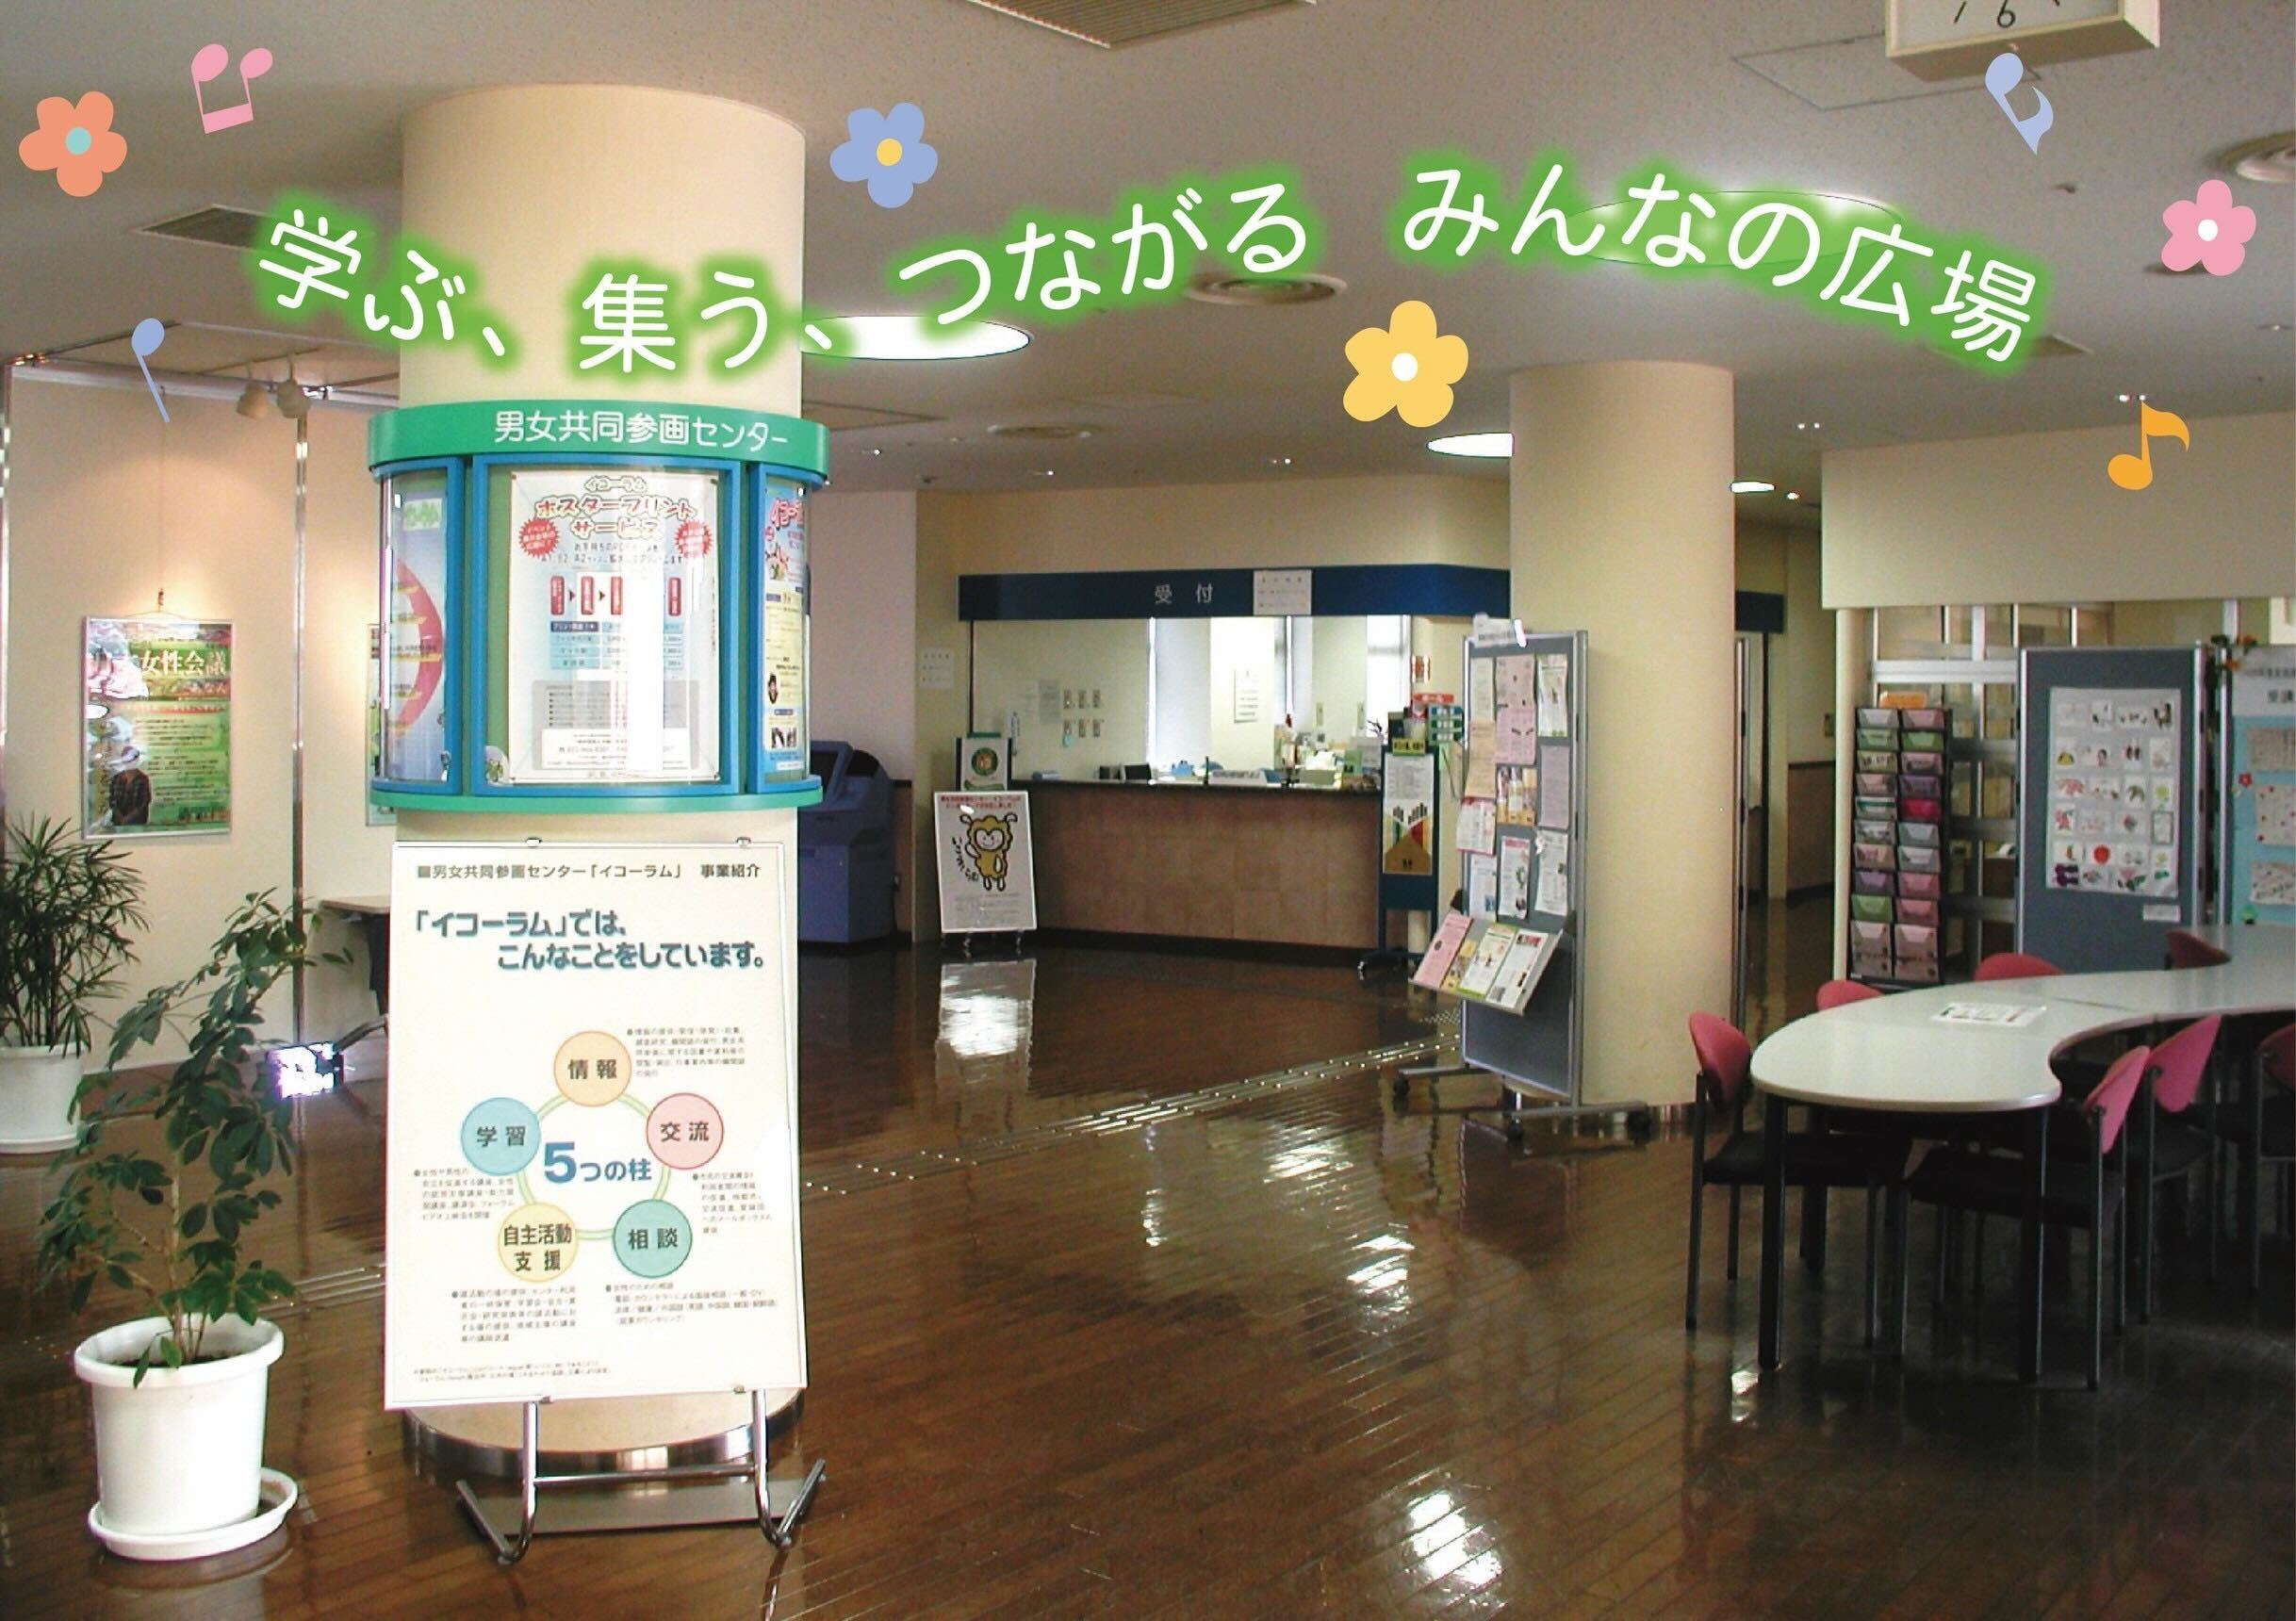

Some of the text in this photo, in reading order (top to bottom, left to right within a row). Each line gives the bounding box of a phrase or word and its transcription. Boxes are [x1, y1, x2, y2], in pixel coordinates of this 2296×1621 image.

[495, 409, 788, 451] 男女共同参画センター
[1154, 581, 1214, 605] 受付
[700, 862, 763, 877] 事業紹介
[415, 909, 628, 938] 「イコーラム」では、
[497, 941, 764, 971] こんなことをしています。
[566, 1057, 617, 1080] 情報
[475, 1124, 527, 1148] 学習
[660, 1121, 711, 1142] 交流
[543, 1141, 653, 1184] 5つの柱
[502, 1222, 572, 1246] 自主活動
[627, 1227, 680, 1251] 相談
[514, 1250, 562, 1272] 支援
